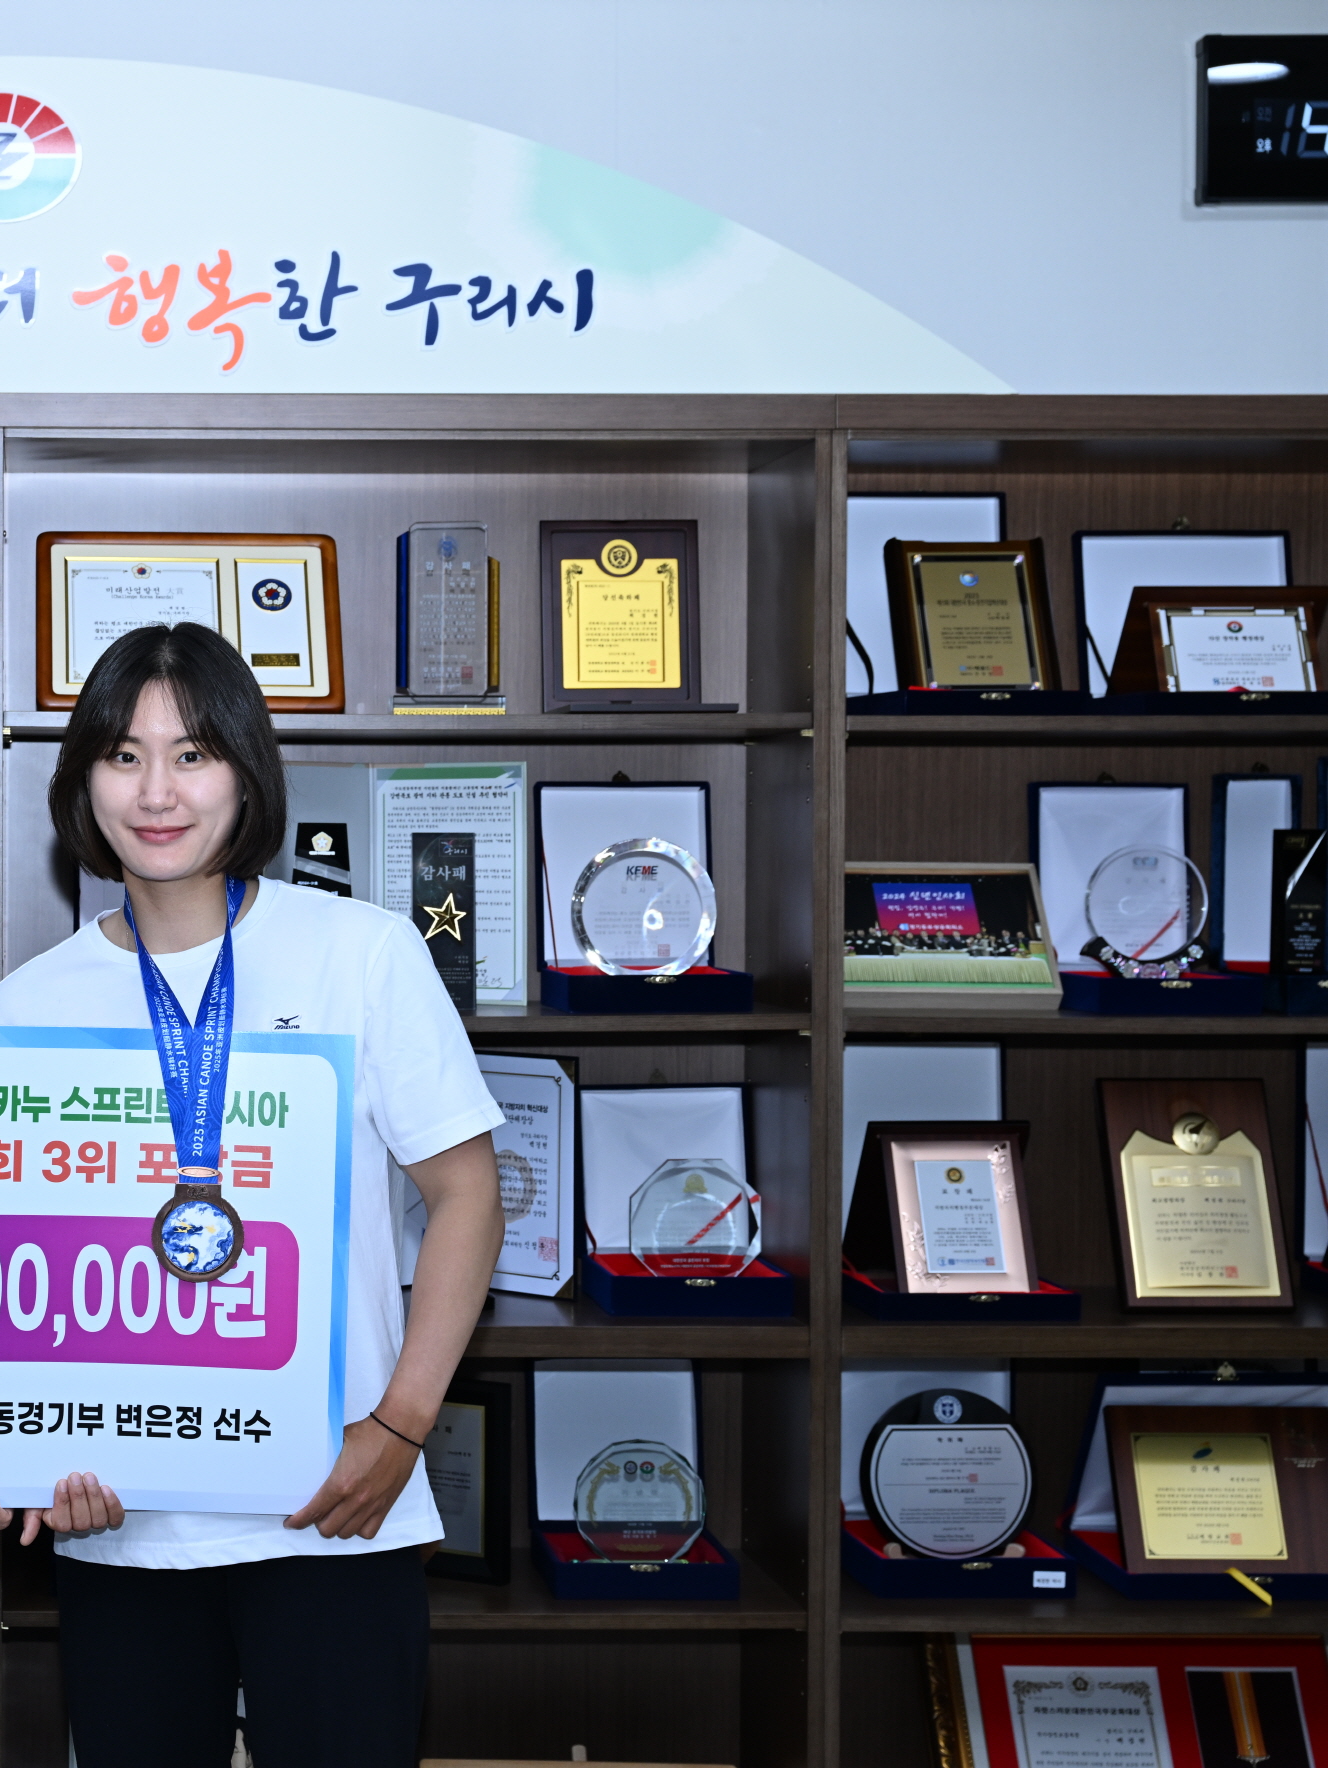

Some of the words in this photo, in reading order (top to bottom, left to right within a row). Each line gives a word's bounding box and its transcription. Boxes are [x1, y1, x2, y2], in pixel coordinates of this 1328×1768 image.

[72, 248, 358, 372] 행복한
[385, 262, 594, 347] 구리시
[420, 865, 466, 881] 감사패
[626, 865, 658, 875] KFME
[169, 1016, 186, 1056] SPRINT
[204, 1006, 218, 1041] SPRINT
[200, 1044, 214, 1086] CANOE
[195, 1089, 209, 1125] ASIAN
[223, 1088, 290, 1129] 시아
[527, 1104, 548, 1113] 혁신대상
[192, 1128, 206, 1156] 2025
[41, 1140, 117, 1184] 3위
[115, 1404, 204, 1438] 변은정
[214, 1407, 273, 1444] 선수
